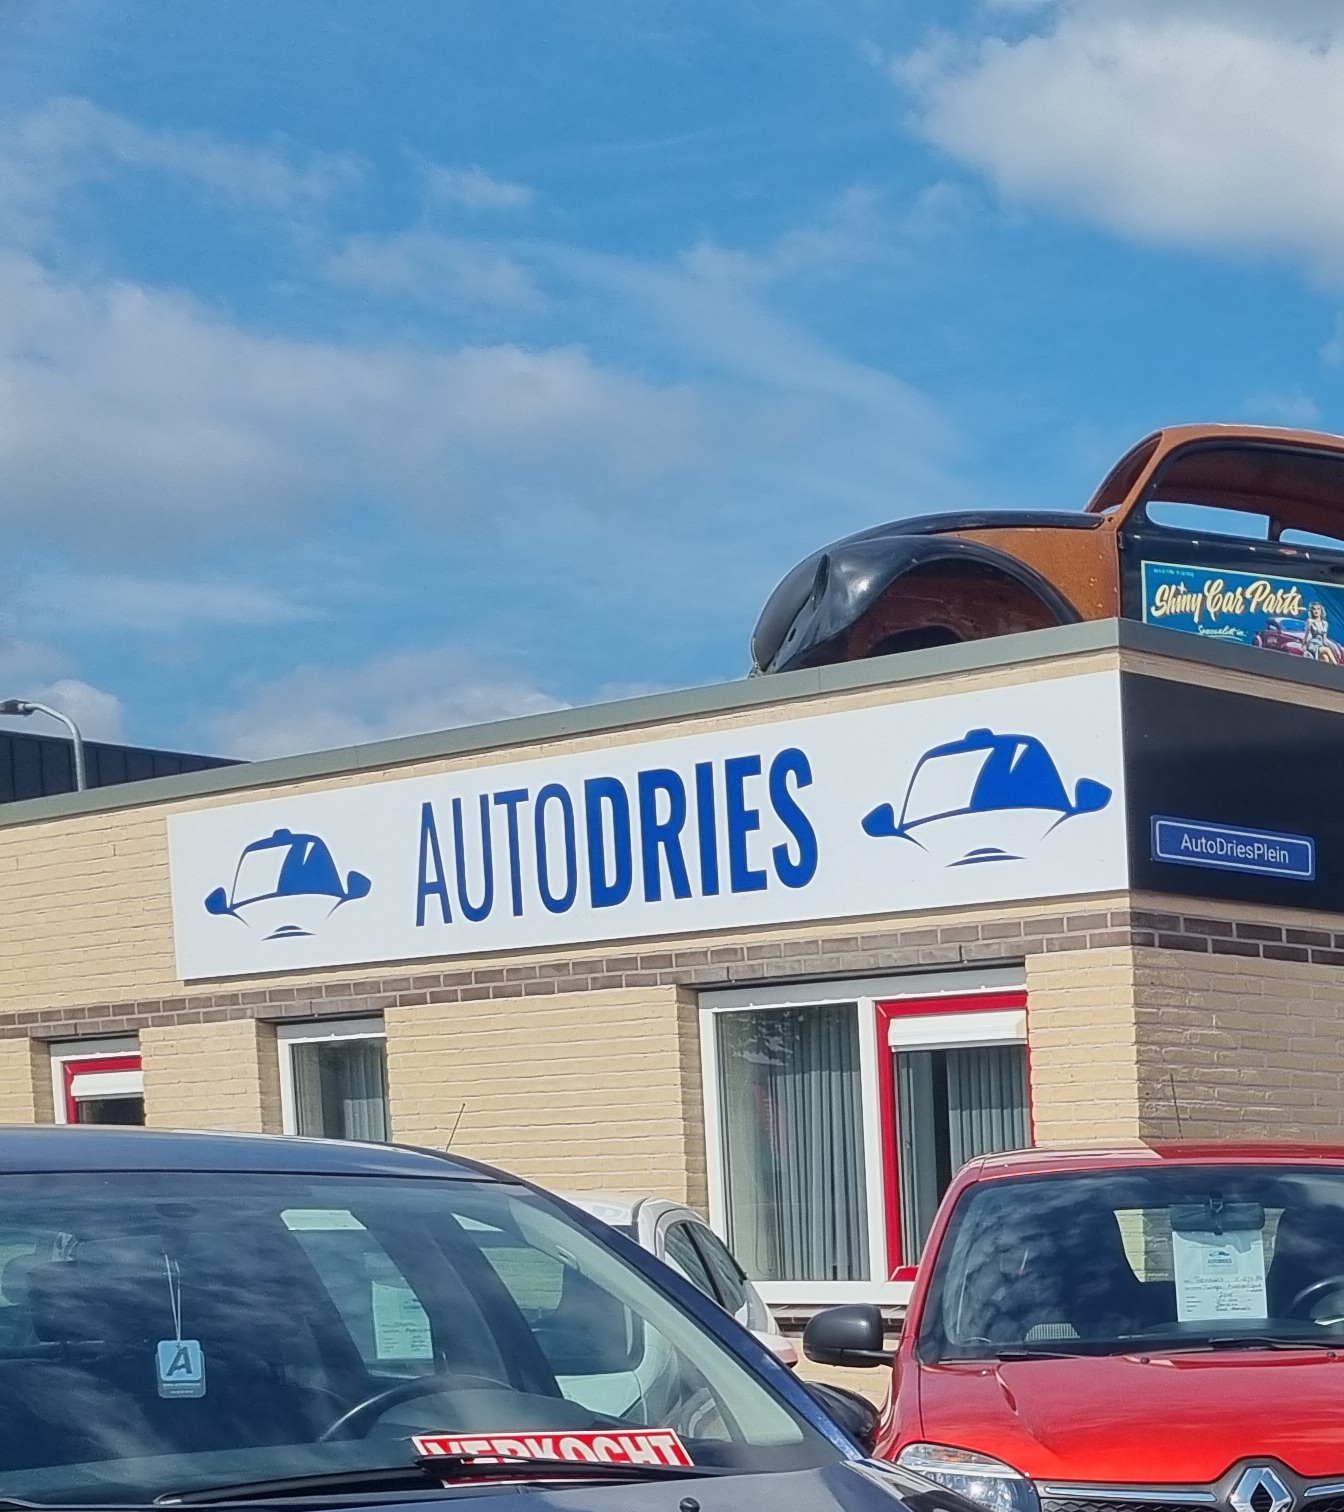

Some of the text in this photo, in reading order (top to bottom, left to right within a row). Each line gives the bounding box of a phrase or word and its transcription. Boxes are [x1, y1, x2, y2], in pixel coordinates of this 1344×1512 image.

[1151, 578, 1307, 624] Shiny Car Parts
[415, 747, 819, 927] AUTODRIES
[1181, 833, 1289, 864] AutoDriesPlein
